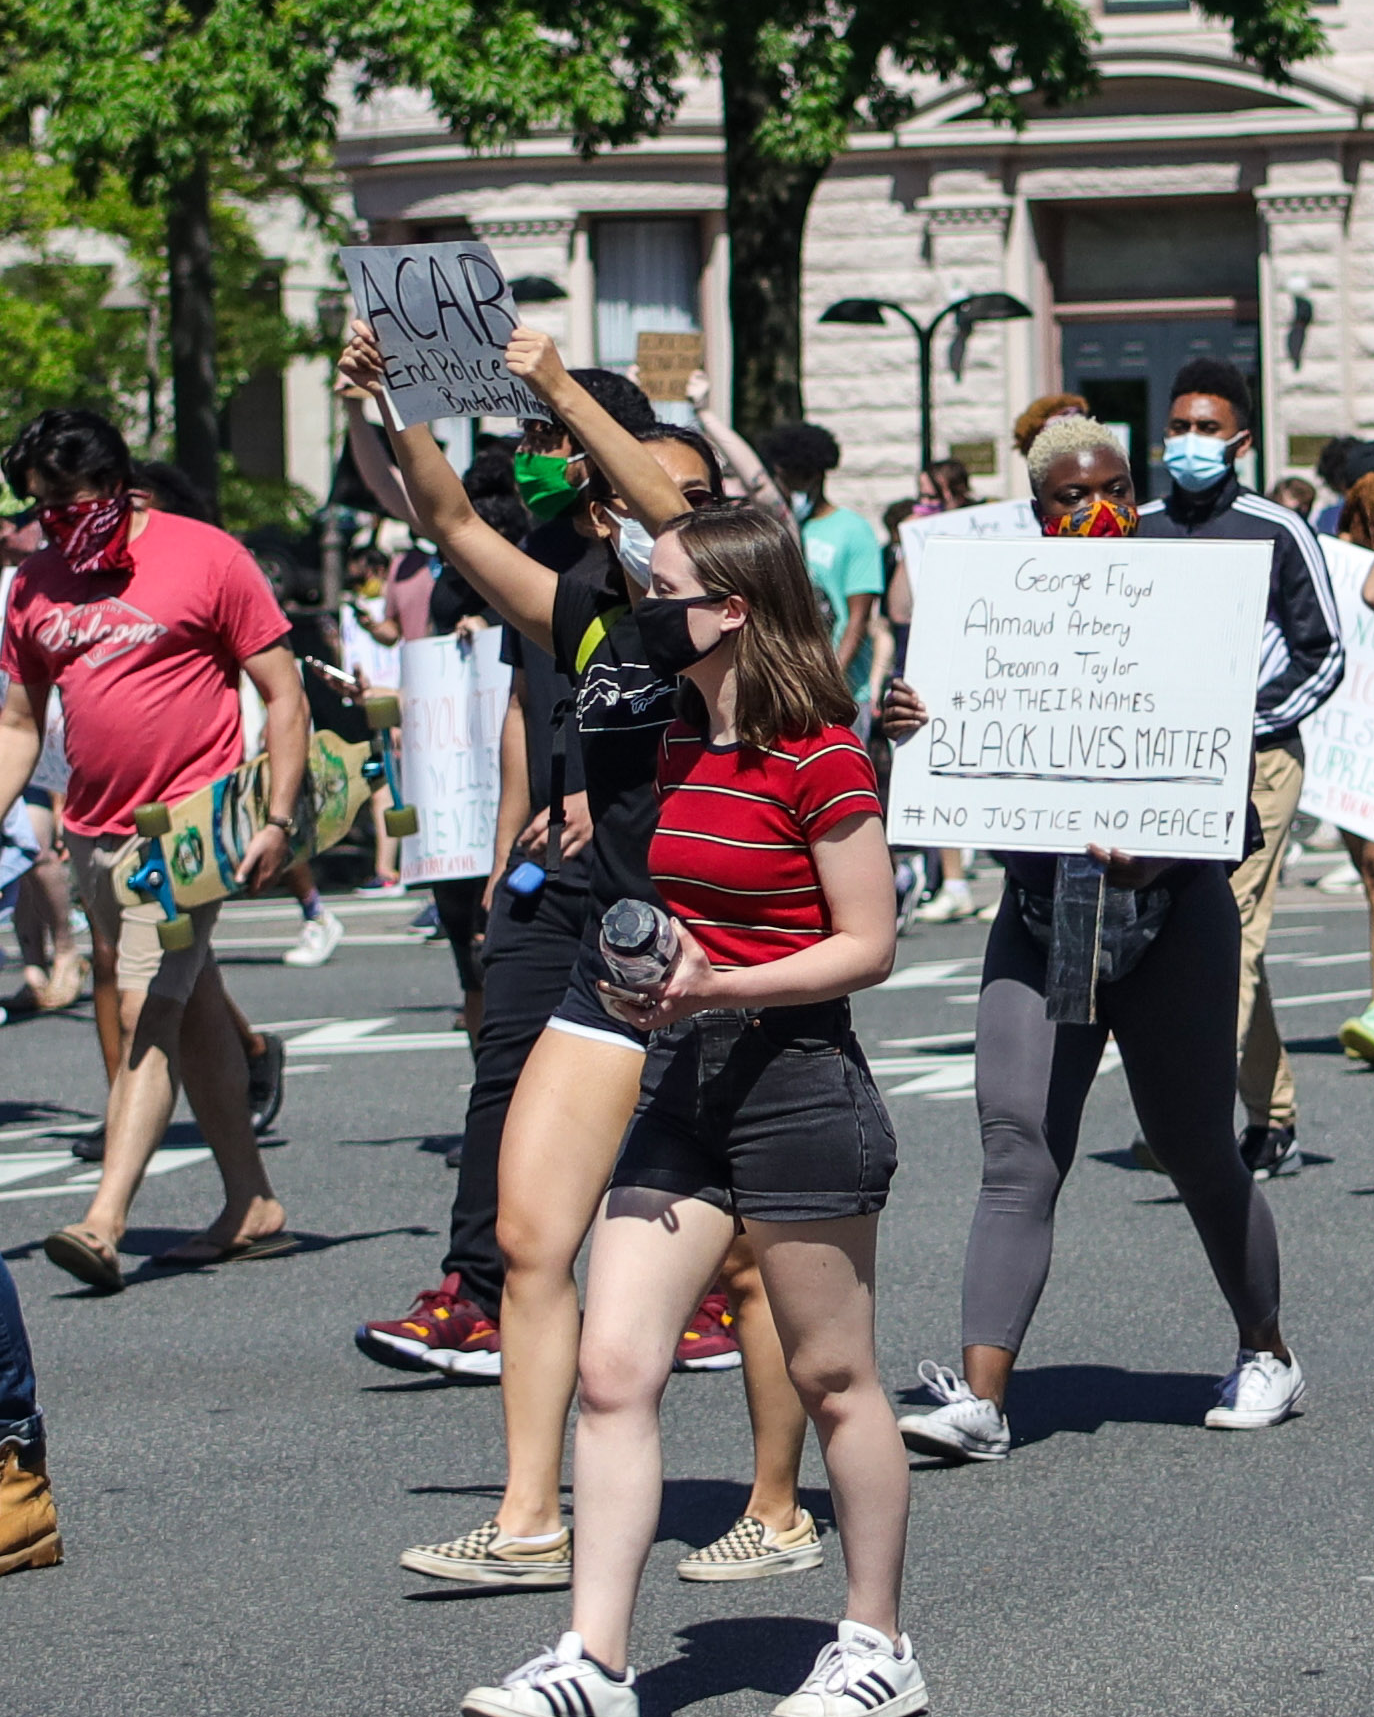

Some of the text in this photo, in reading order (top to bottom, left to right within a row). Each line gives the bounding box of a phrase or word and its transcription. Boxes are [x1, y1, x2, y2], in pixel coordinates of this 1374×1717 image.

[361, 254, 518, 351] ACAB
[384, 348, 508, 390] End Police
[1014, 557, 1153, 608] George Floyd
[963, 598, 1131, 647] Ahmaud Arbery
[985, 646, 1139, 684] Breonna Taylor
[951, 688, 1007, 714] #SAY
[928, 717, 1232, 775] BLACK LIVES MATTER
[983, 806, 1082, 831] JUSTICE
[1094, 810, 1129, 830] NO
[1139, 808, 1235, 845] PEACE!
